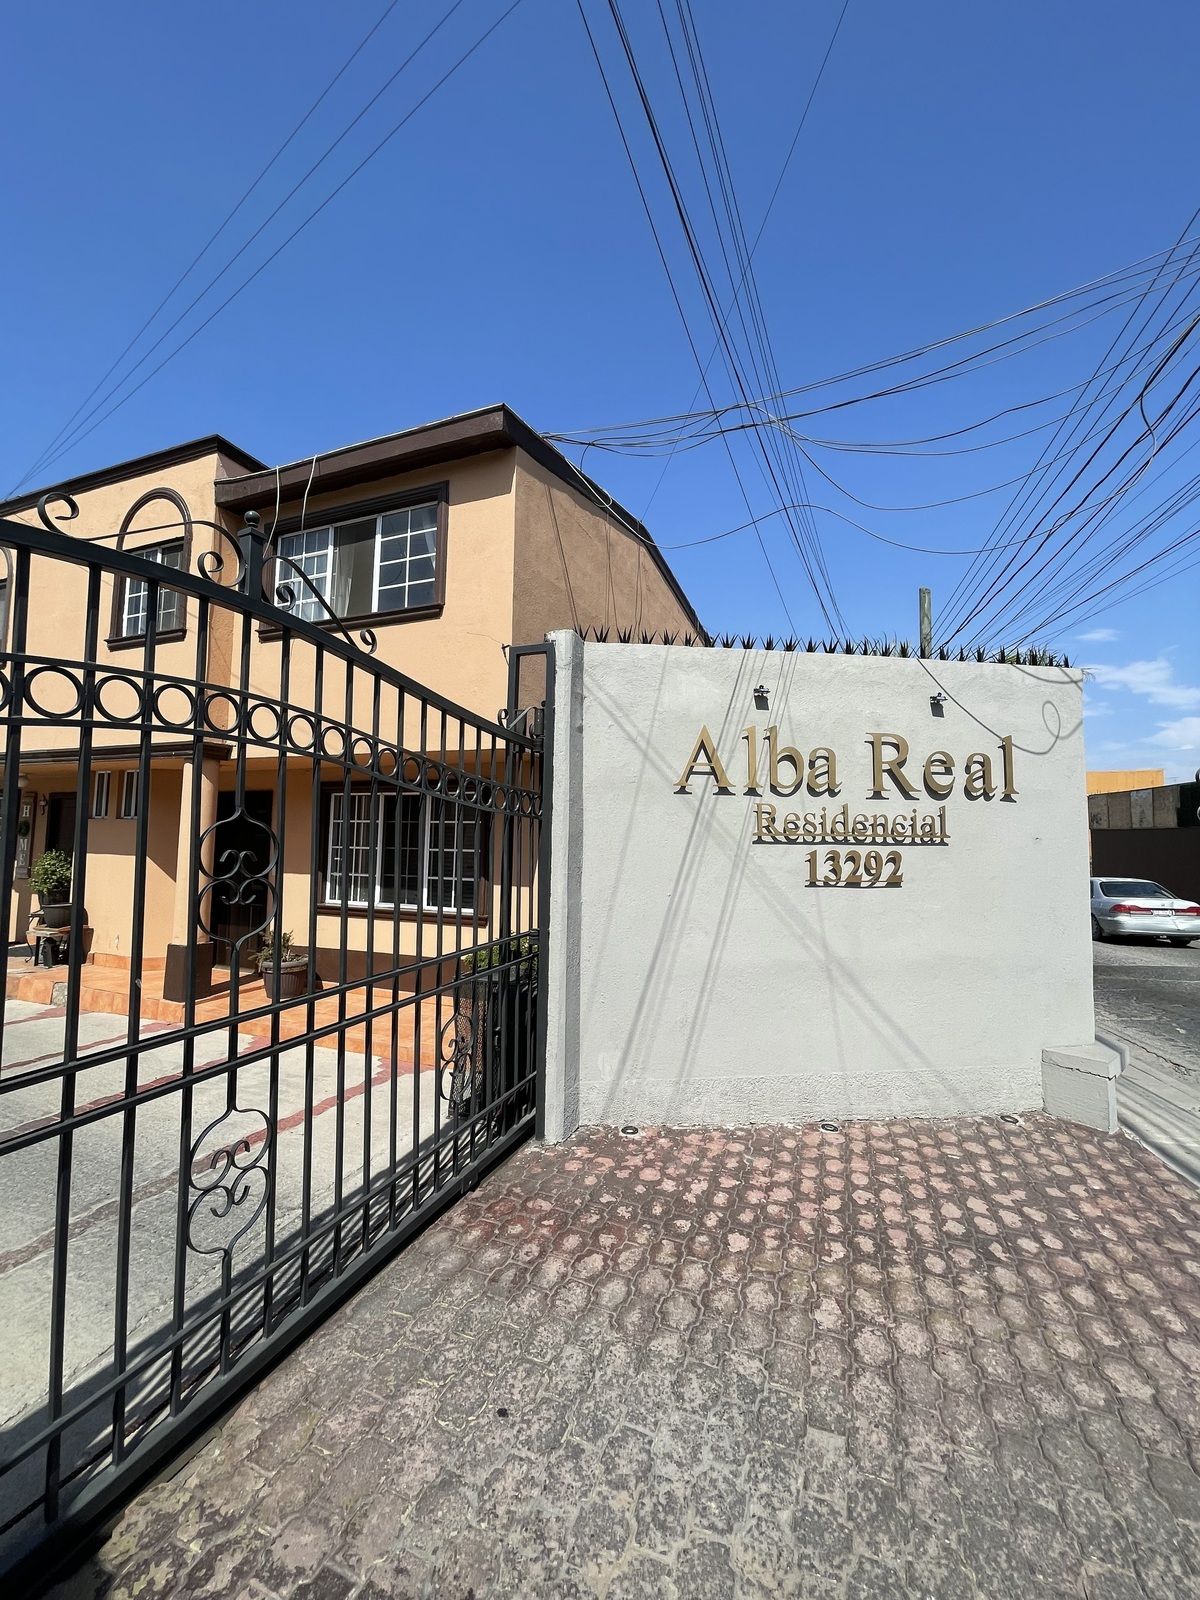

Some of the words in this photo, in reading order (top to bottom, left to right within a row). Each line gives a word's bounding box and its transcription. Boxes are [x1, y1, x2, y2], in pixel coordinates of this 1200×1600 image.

[673, 724, 843, 796] Alba
[865, 732, 1020, 801] Real
[753, 803, 950, 842] Residencial
[805, 850, 904, 886] 13292
